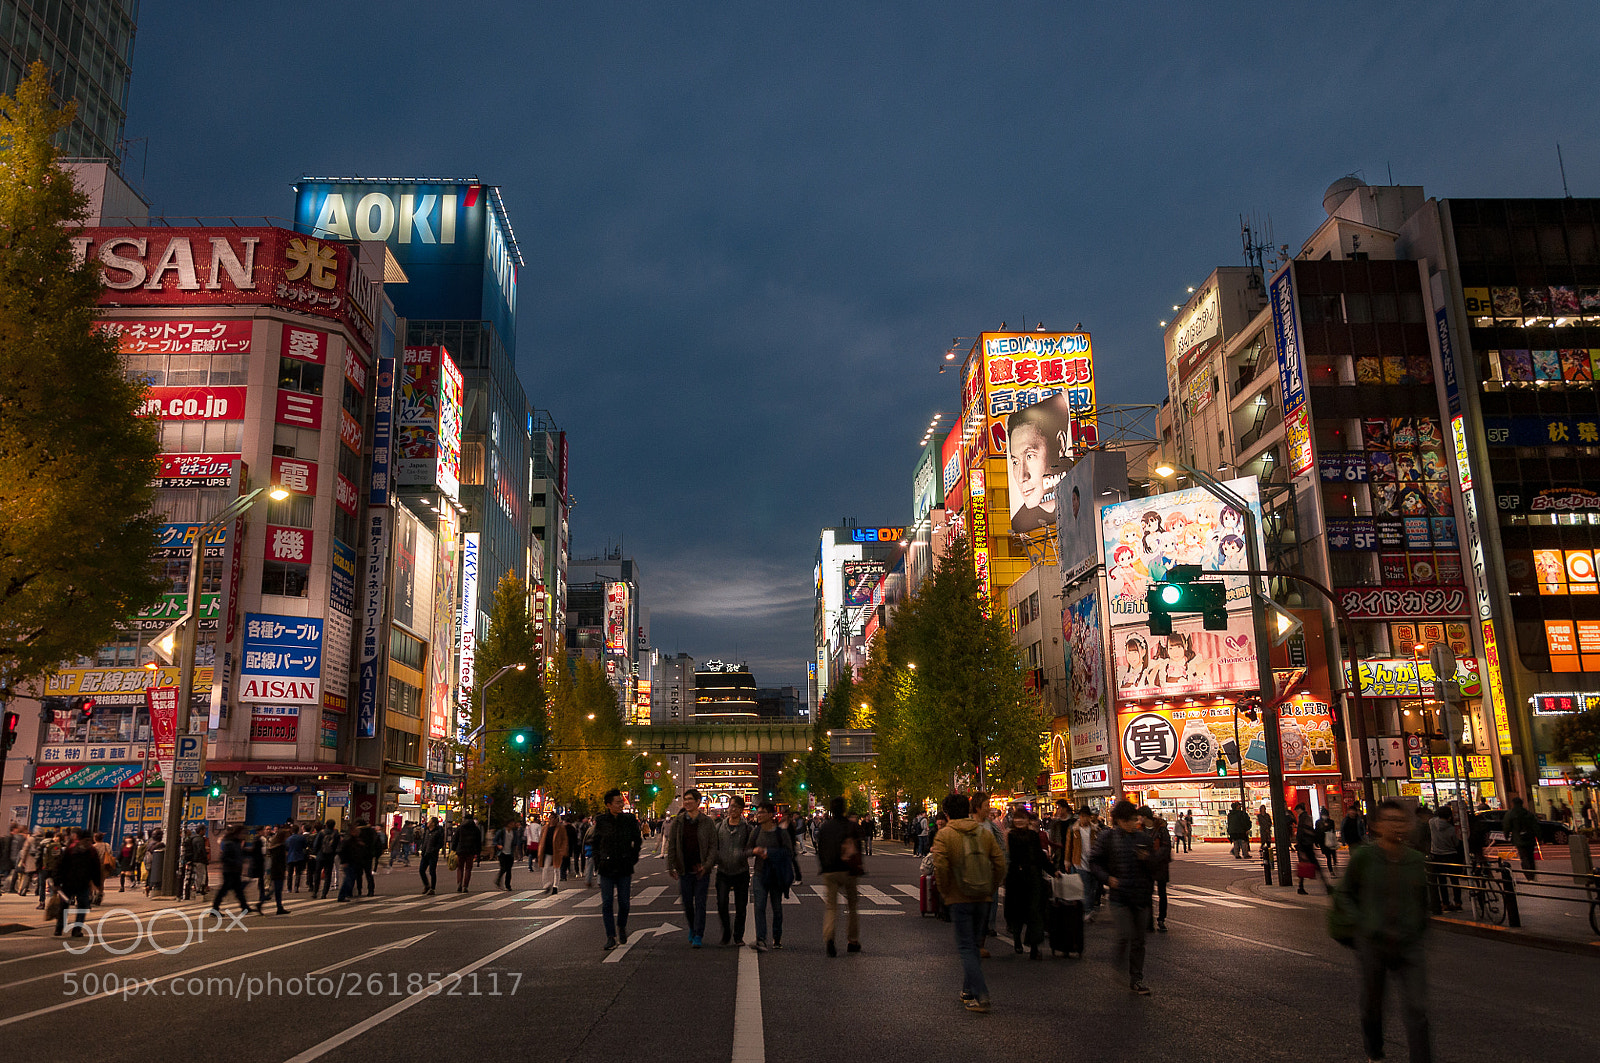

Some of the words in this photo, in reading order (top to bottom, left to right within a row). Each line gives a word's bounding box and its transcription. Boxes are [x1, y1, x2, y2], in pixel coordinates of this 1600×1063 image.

[312, 193, 457, 244] AOKI
[284, 238, 338, 290] 光
[276, 284, 341, 310] ネットワーク
[1466, 298, 1491, 312] 8F
[288, 329, 319, 360] 愛
[989, 358, 1090, 384] 激安販売
[283, 395, 313, 424] 三
[373, 396, 391, 490] 愛三電機
[1488, 429, 1509, 441] 5F
[279, 461, 310, 492] 電
[1344, 466, 1367, 481] 6F
[1499, 496, 1519, 509] 5F
[272, 529, 305, 561] 機
[852, 528, 904, 541] LAOX
[1354, 533, 1375, 548] 5F
[465, 539, 478, 582] AKKY
[1470, 536, 1488, 603] ルノアール
[1342, 589, 1464, 615] メイドカジノ
[248, 620, 319, 641] 各種ケーブル
[462, 629, 475, 683] Tax-free
[1551, 643, 1573, 651] Free
[246, 651, 317, 672] 配線パーツ
[50, 675, 76, 690] B1F
[243, 680, 315, 700] AISAN
[1374, 684, 1418, 695] ゲラゲラ
[360, 665, 375, 730] AISAN
[1495, 670, 1503, 695] TAX
[1500, 699, 1509, 731] FREE
[250, 724, 296, 740] aisan.co.jp
[1128, 720, 1170, 768] 質
[45, 748, 60, 760] 各社
[64, 748, 81, 760] 特約
[90, 748, 106, 759] 在庫
[110, 747, 126, 759] 直販
[179, 738, 197, 757] P
